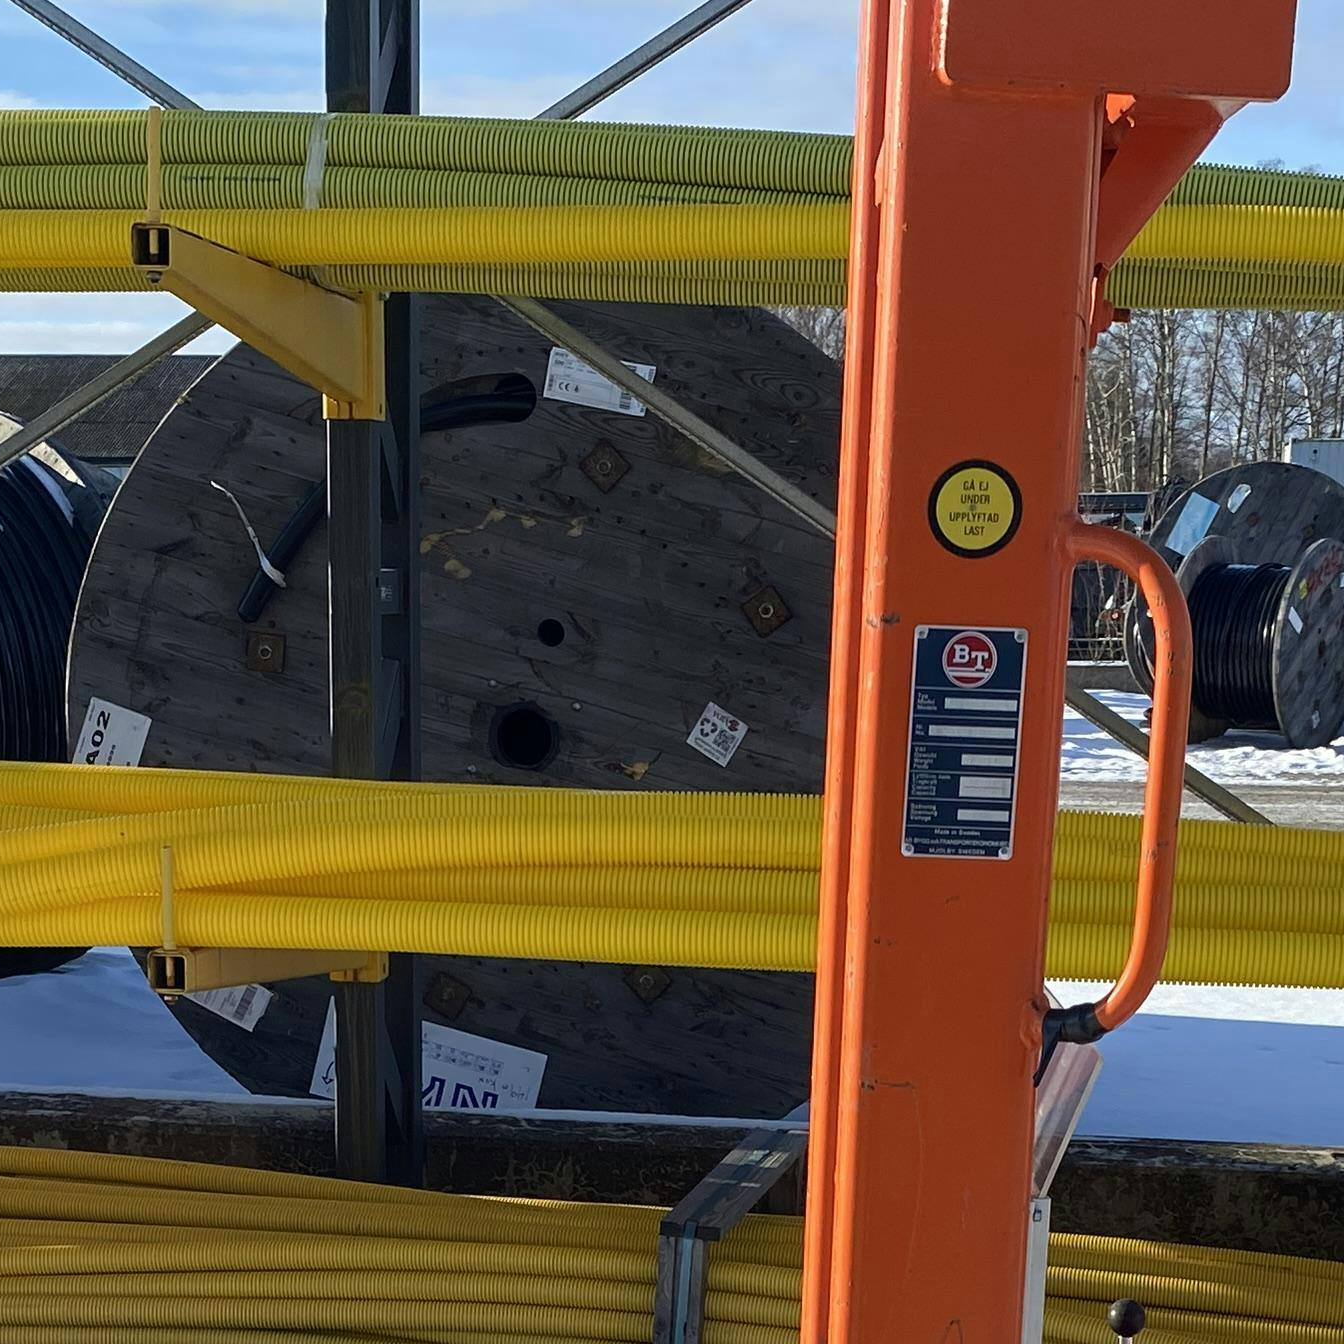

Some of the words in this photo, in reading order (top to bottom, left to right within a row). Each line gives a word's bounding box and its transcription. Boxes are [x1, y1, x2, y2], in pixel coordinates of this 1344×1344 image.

[963, 478, 975, 491] GÅ
[979, 481, 989, 491] EJ
[960, 494, 990, 505] UNDER
[949, 512, 1000, 523] UPPLYFTAD
[964, 526, 985, 537] LAST
[952, 643, 989, 671] BT
